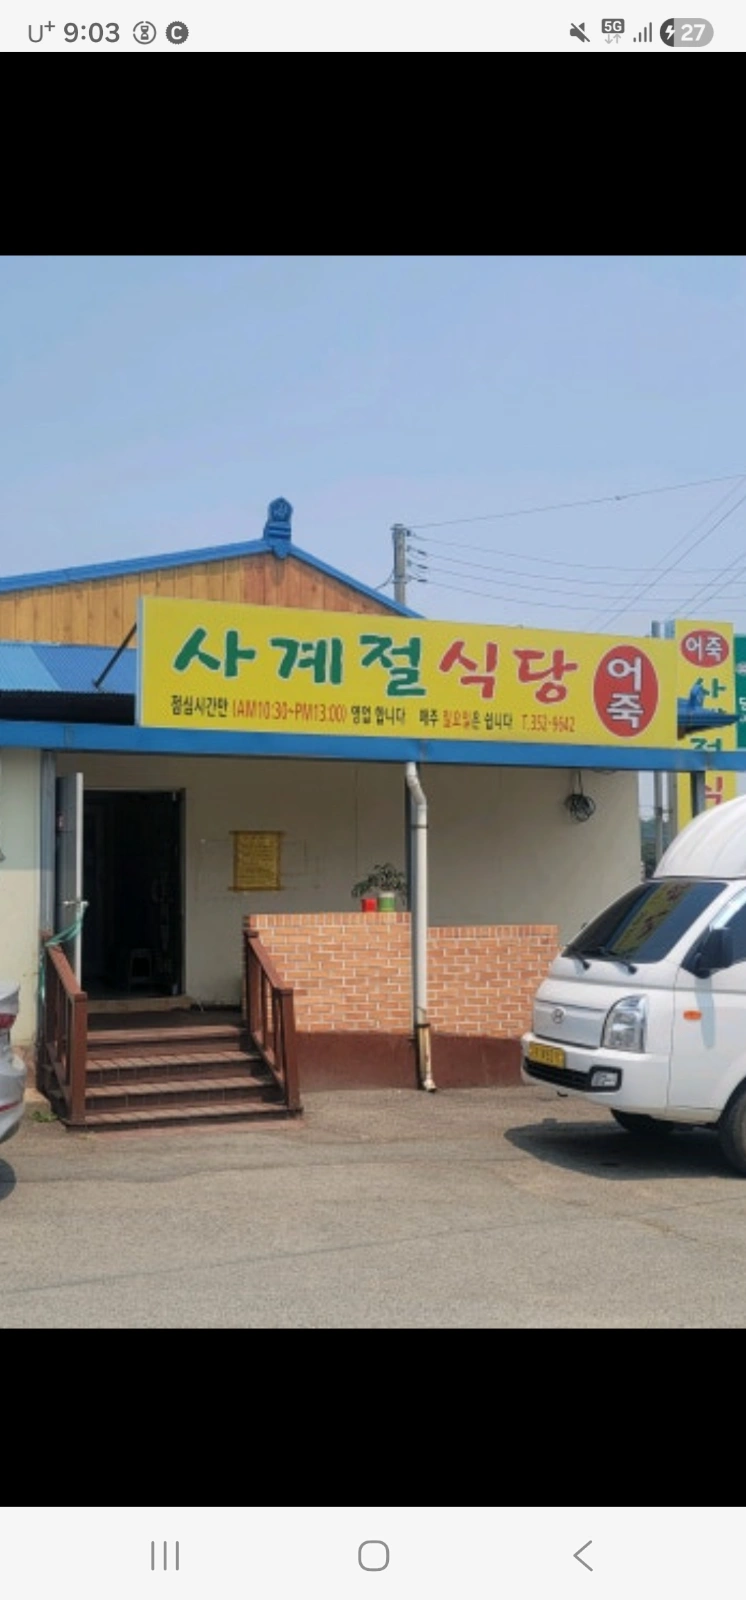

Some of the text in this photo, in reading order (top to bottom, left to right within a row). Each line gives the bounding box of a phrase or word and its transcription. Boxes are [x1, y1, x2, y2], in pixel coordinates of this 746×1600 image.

[173, 627, 578, 704] 사계절식당
[685, 635, 723, 662] 어죽
[171, 694, 229, 718] 점심시간만
[375, 705, 406, 726] 합니다
[419, 709, 439, 728] 매주
[484, 711, 513, 731] 쉽니다
[607, 656, 644, 728] 어죽
